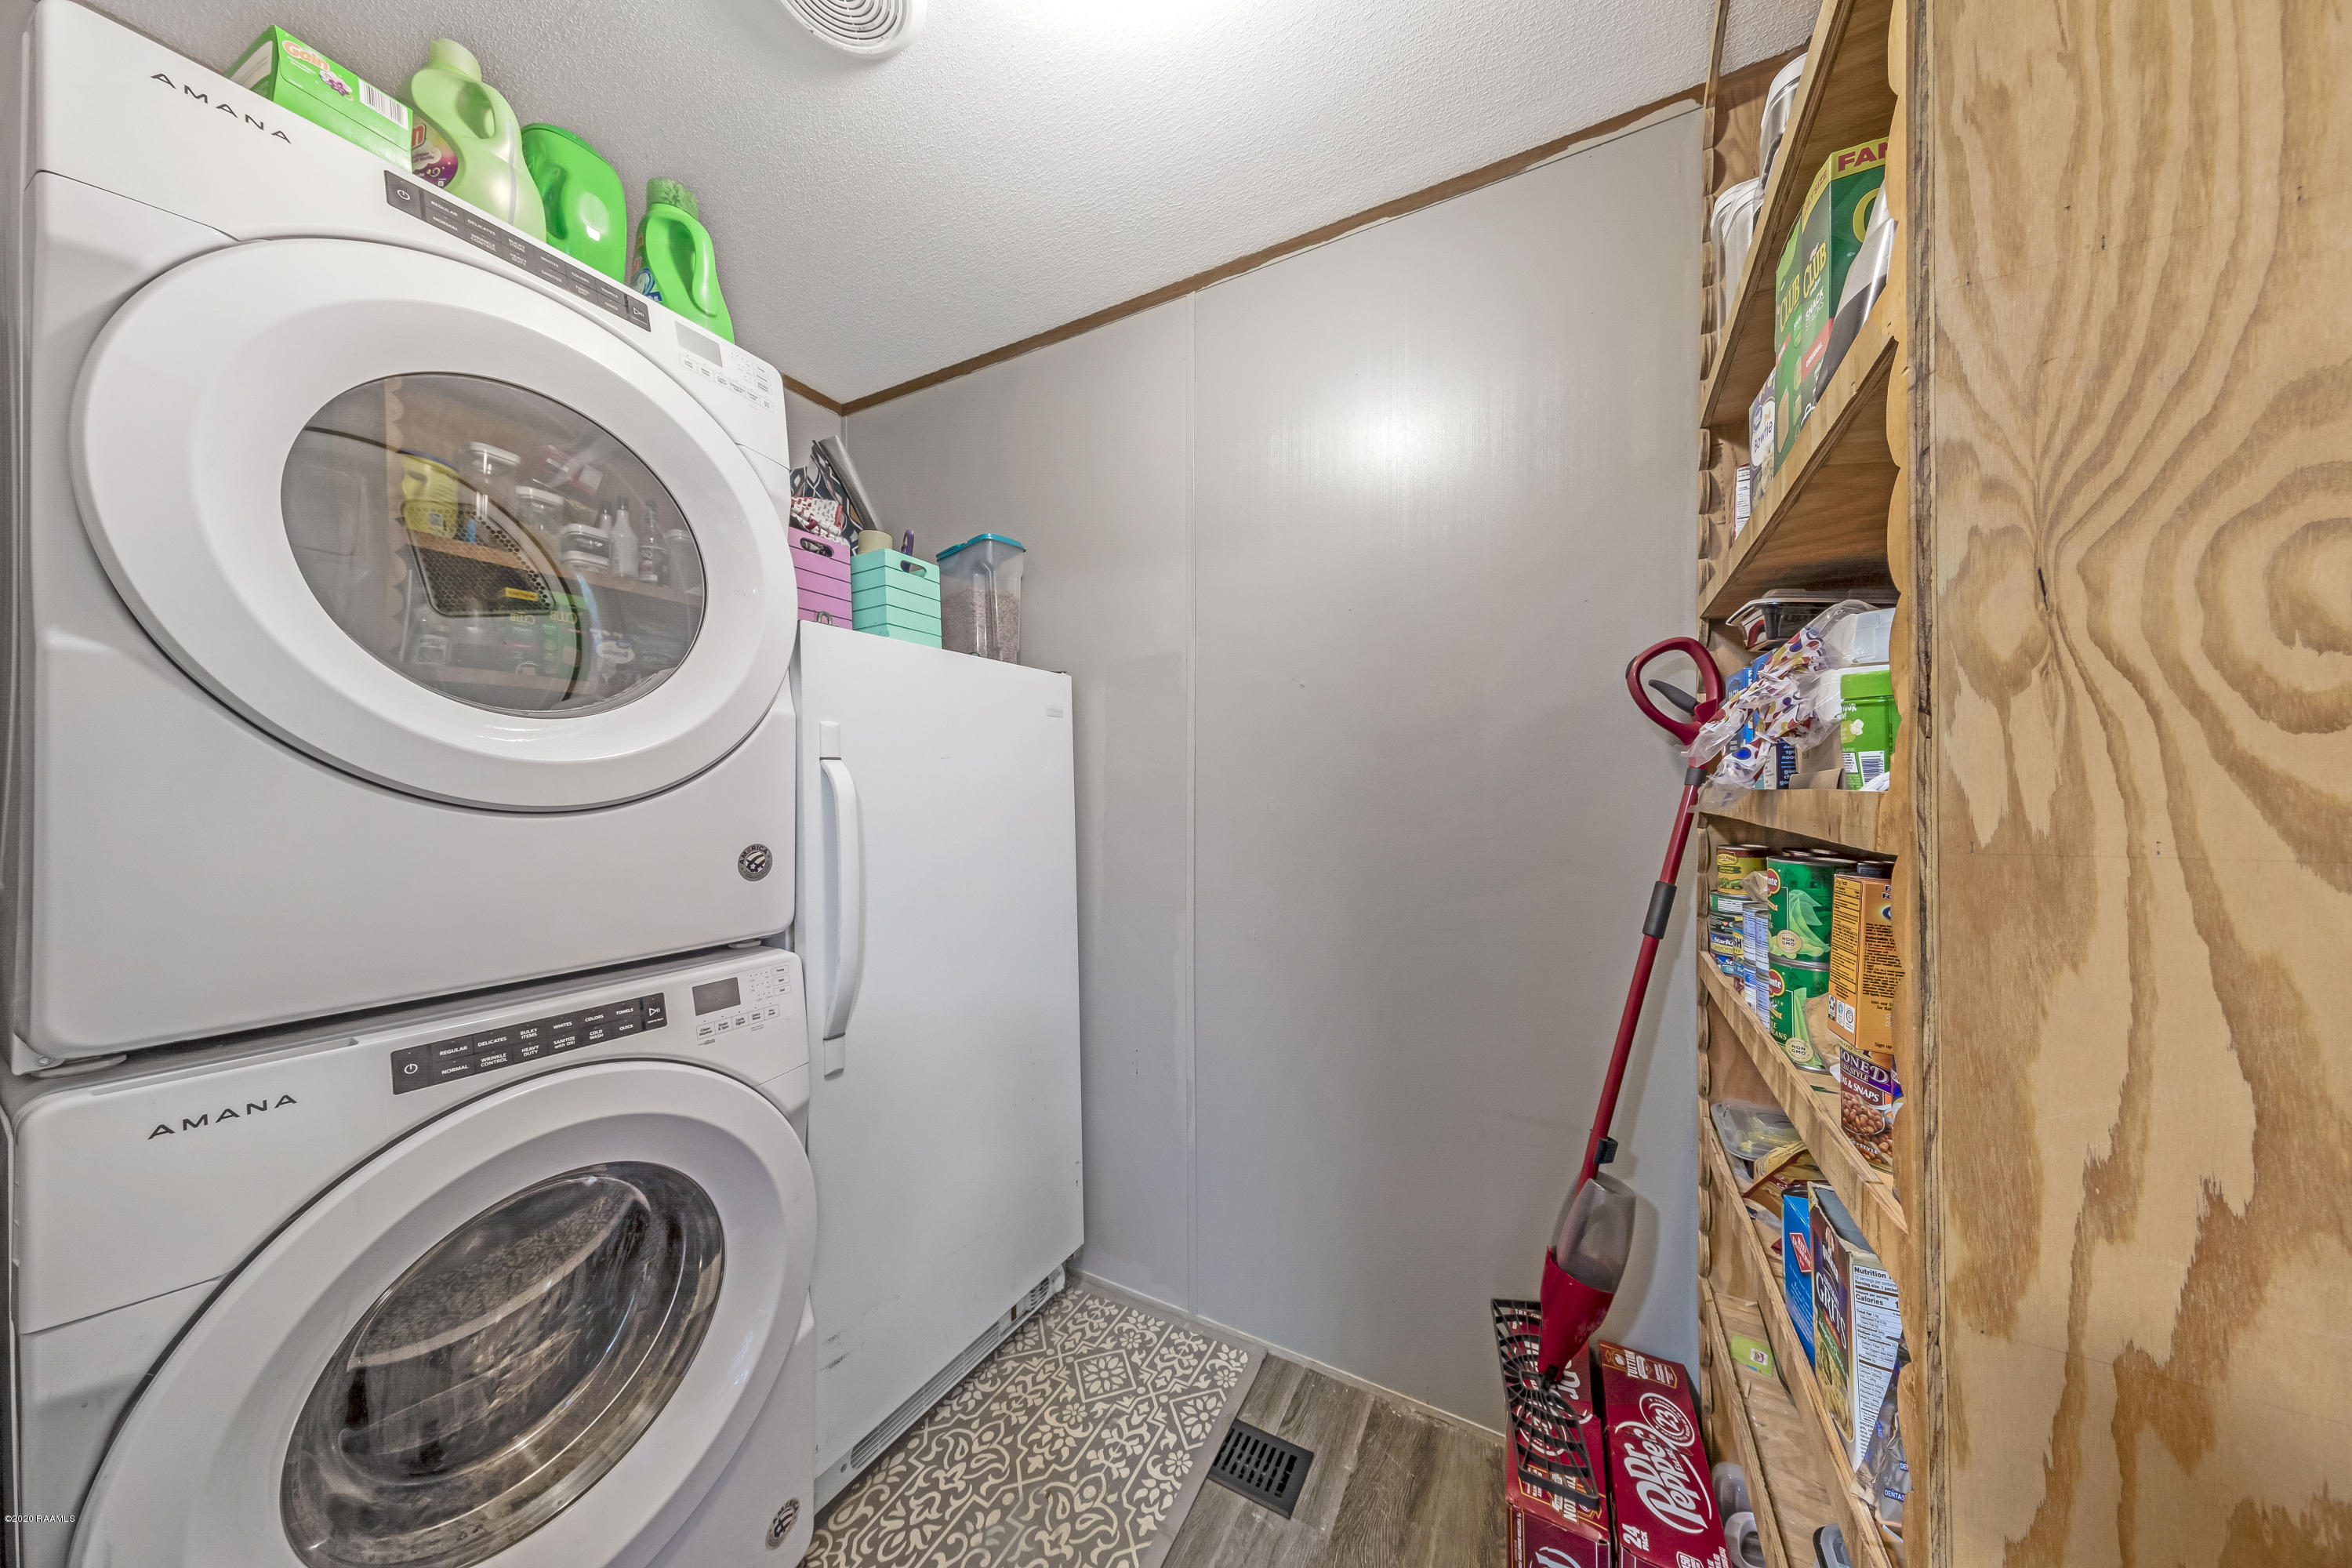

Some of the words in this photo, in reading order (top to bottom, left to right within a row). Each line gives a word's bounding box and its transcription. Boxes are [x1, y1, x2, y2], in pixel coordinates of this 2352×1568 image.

[283, 40, 330, 72] Gain
[150, 73, 292, 144] AMANA
[430, 200, 459, 217] REGULAR
[433, 216, 459, 232] NORMAL
[467, 219, 496, 237] DELICATES
[1802, 241, 1827, 299] CLUB
[1780, 273, 1800, 333] CLUB
[1806, 285, 1824, 321] SNACK
[1806, 341, 1824, 368] ORIGINAL
[739, 845, 768, 865] AMERICA
[1714, 936, 1733, 946] StarKi
[1769, 978, 1782, 989] nte
[585, 1014, 604, 1022] COLORS
[439, 1045, 468, 1056] REGULAR
[477, 1036, 507, 1047] DELICATES
[553, 1036, 575, 1045] SANITIZE
[480, 1057, 508, 1067] CONTROL
[481, 1053, 507, 1063] WRINKLE
[1840, 1048, 1889, 1083] SONED
[441, 1065, 469, 1075] NORMAL
[1849, 1068, 1869, 1083] STYLE
[1847, 1080, 1853, 1090] &
[1853, 1083, 1880, 1103] SNAPS
[147, 1094, 299, 1141] AMANA
[1854, 1266, 1886, 1279] Nutrition
[1856, 1294, 1884, 1306] Calories
[1816, 1271, 1847, 1350] GRITS
[1624, 1349, 1639, 1379] TUITION
[1658, 1407, 1679, 1432] 23
[1624, 1443, 1658, 1477] Dr
[1634, 1428, 1708, 1534] Pepper
[1885, 1488, 1905, 1501] DENTAS
[1621, 1523, 1642, 1549] 24
[1640, 1530, 1650, 1552] PACK
